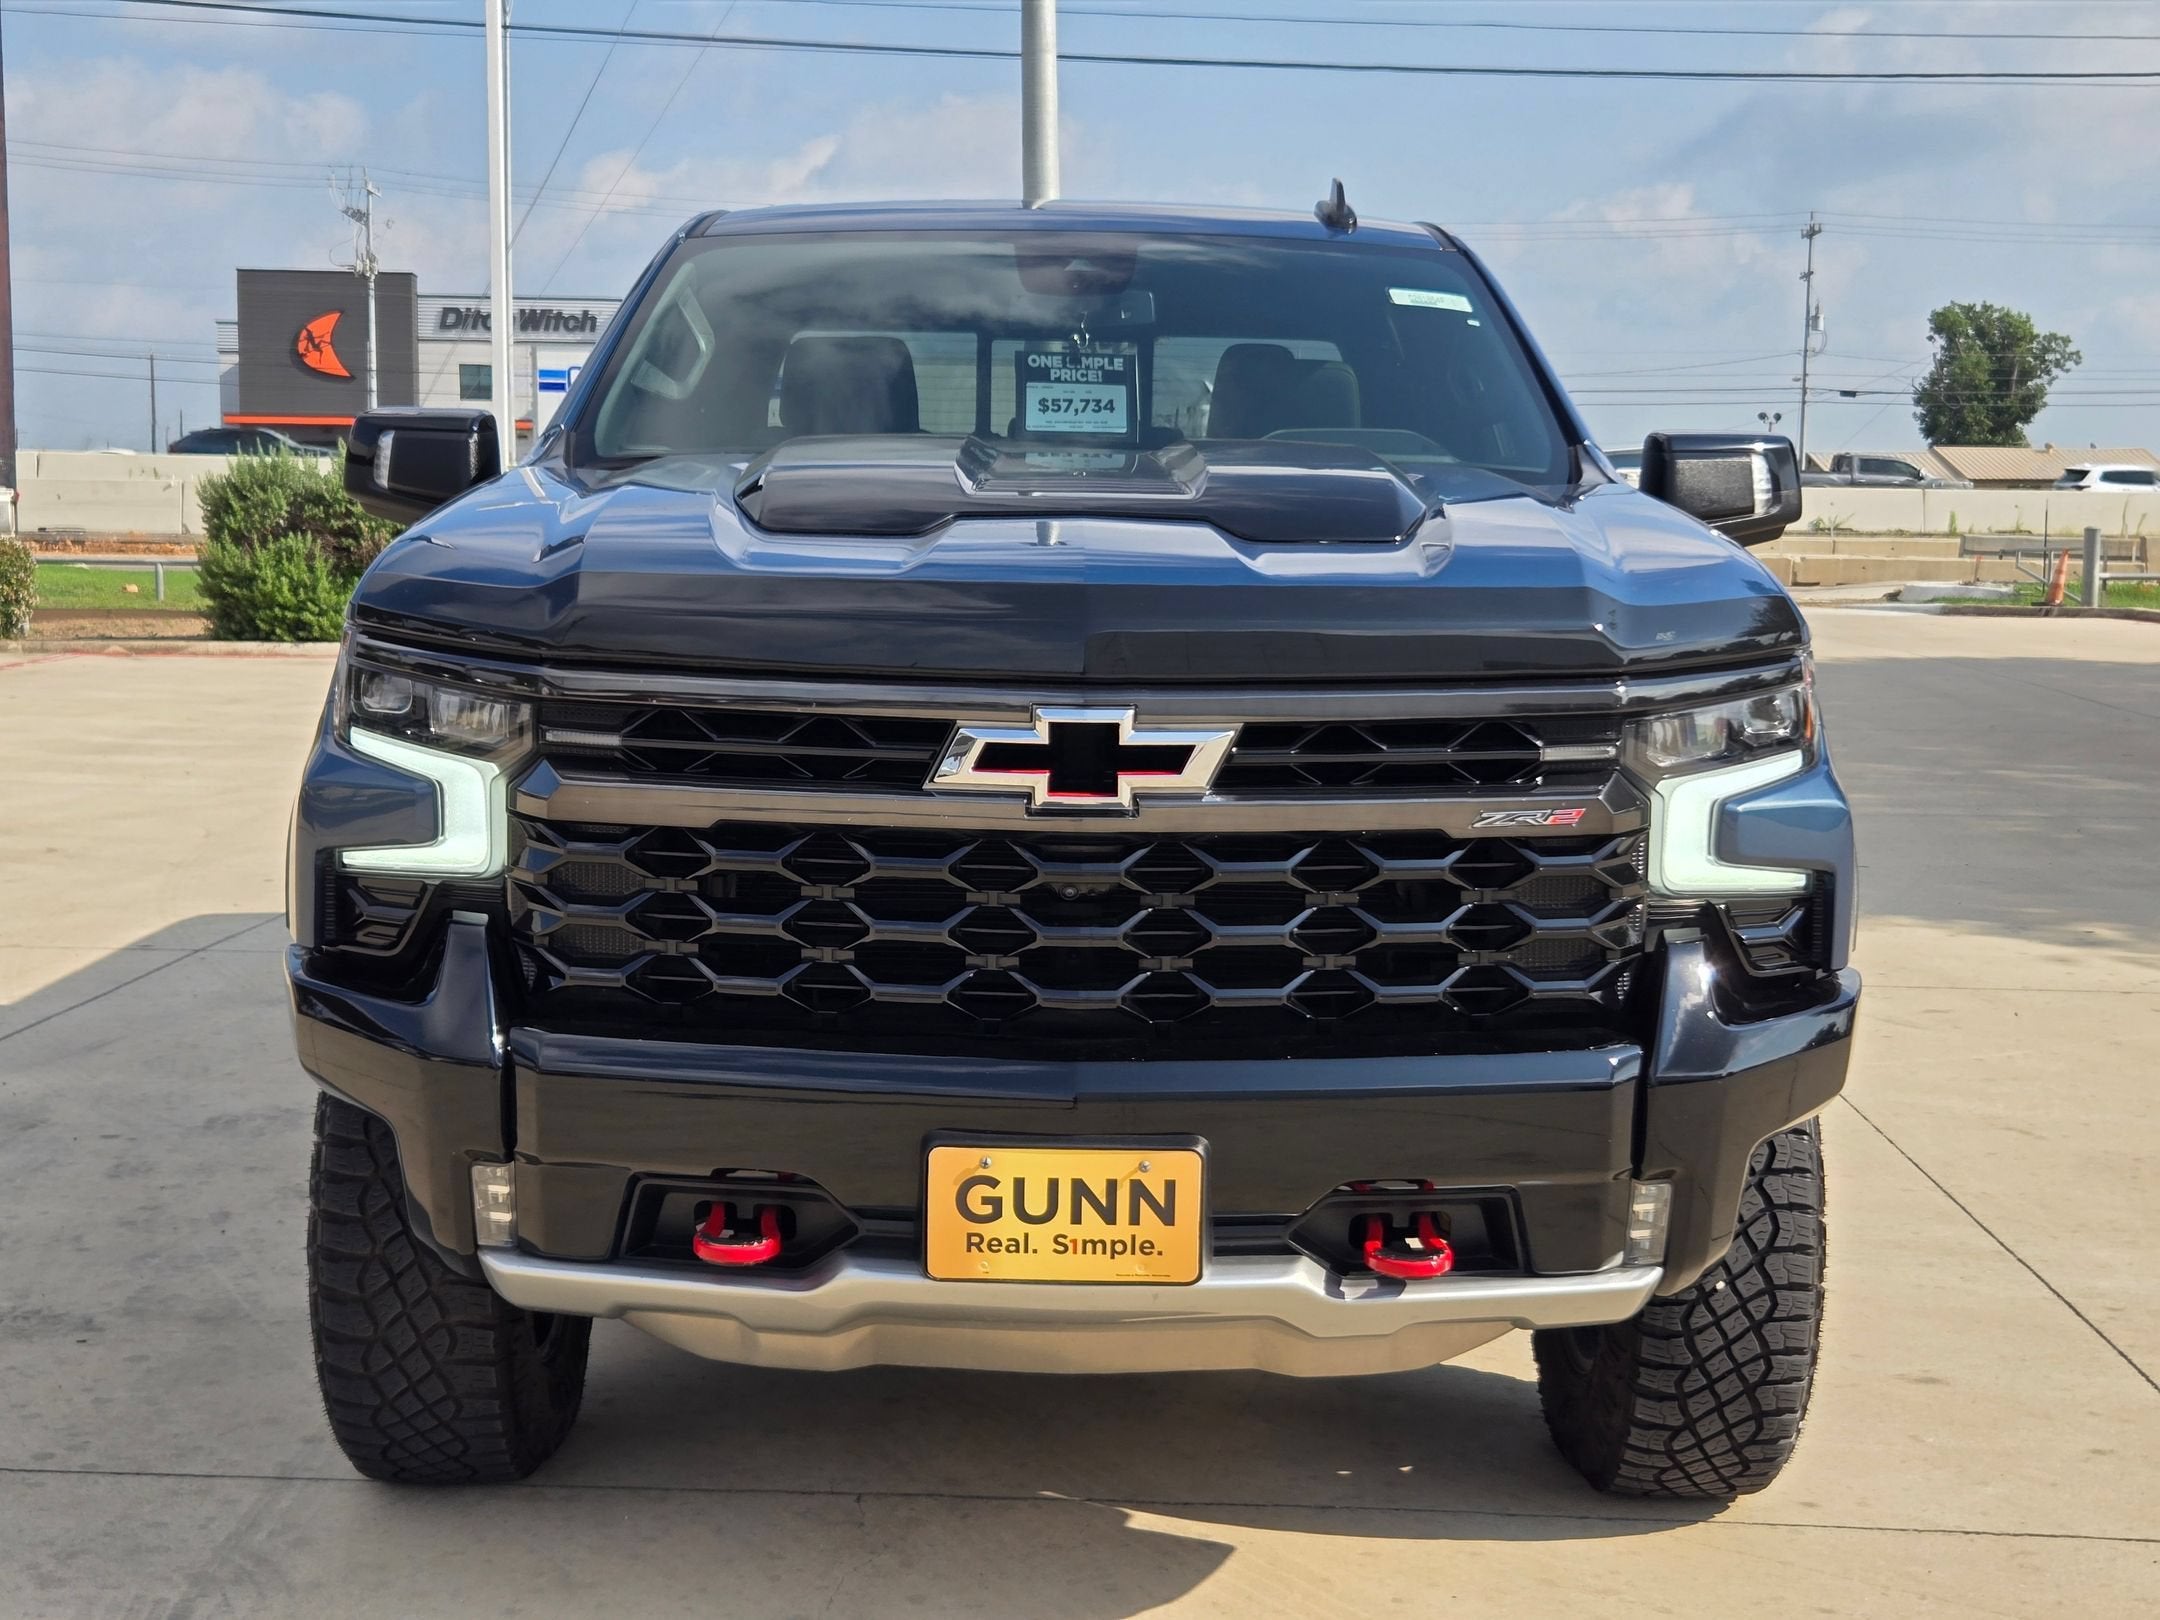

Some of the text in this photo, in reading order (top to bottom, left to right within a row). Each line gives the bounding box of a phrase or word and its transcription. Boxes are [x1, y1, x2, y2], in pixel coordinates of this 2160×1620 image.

[519, 309, 598, 333] Witch
[1027, 354, 1124, 371] ONE MPLE
[1050, 368, 1102, 382] PRICE!
[1038, 397, 1115, 416] $57,734
[1472, 808, 1586, 828] ZR2
[955, 1174, 1176, 1227] GUNN
[966, 1232, 1038, 1254] Real.
